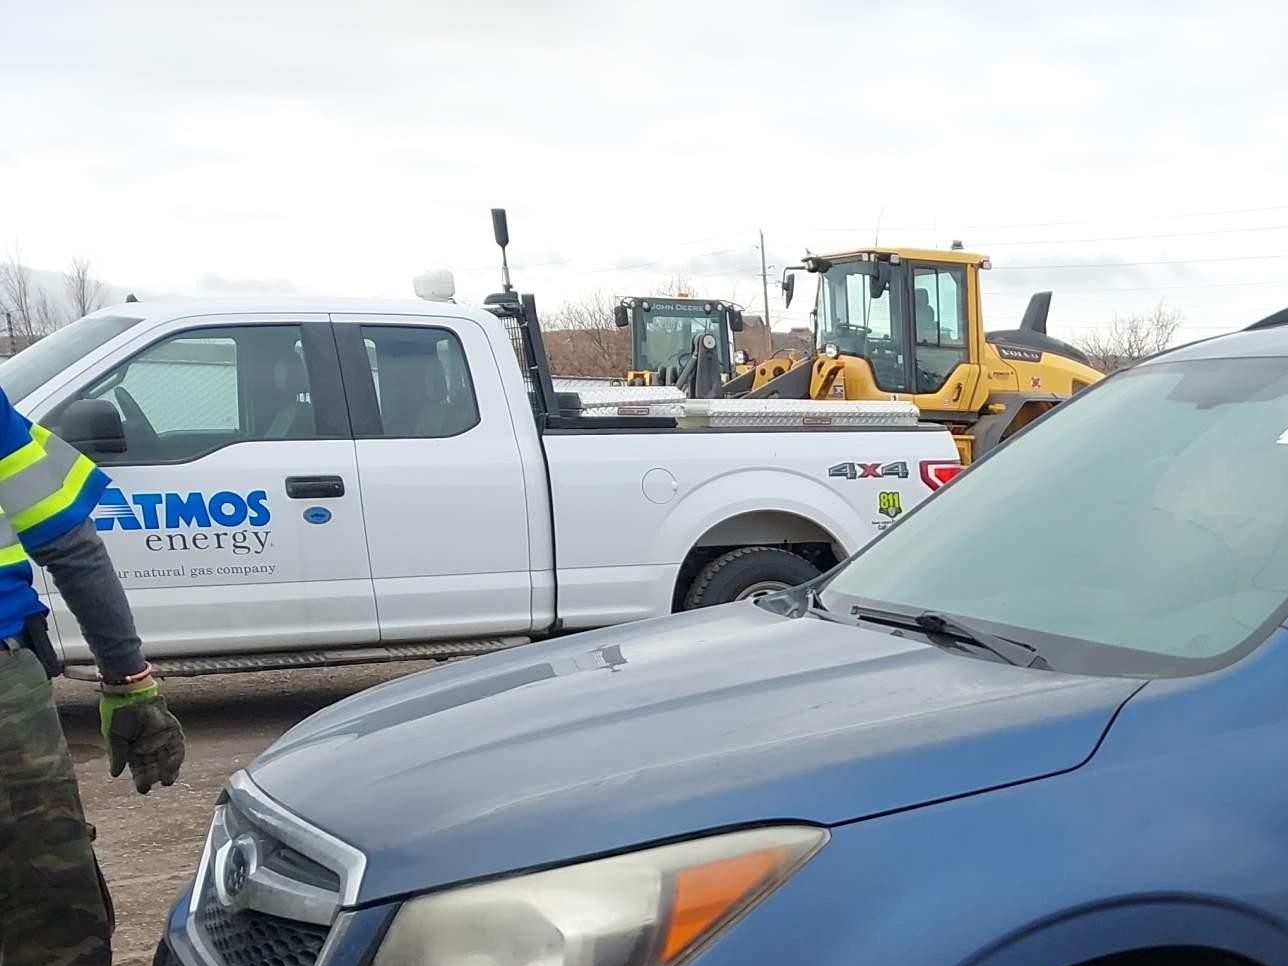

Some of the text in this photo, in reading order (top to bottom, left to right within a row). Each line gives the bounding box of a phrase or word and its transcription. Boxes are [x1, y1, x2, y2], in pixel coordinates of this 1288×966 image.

[95, 487, 271, 531] ATMOS
[880, 493, 899, 510] 811
[145, 529, 272, 555] energy
[134, 565, 185, 578] natural
[190, 567, 213, 578] gas
[216, 564, 276, 576] company
